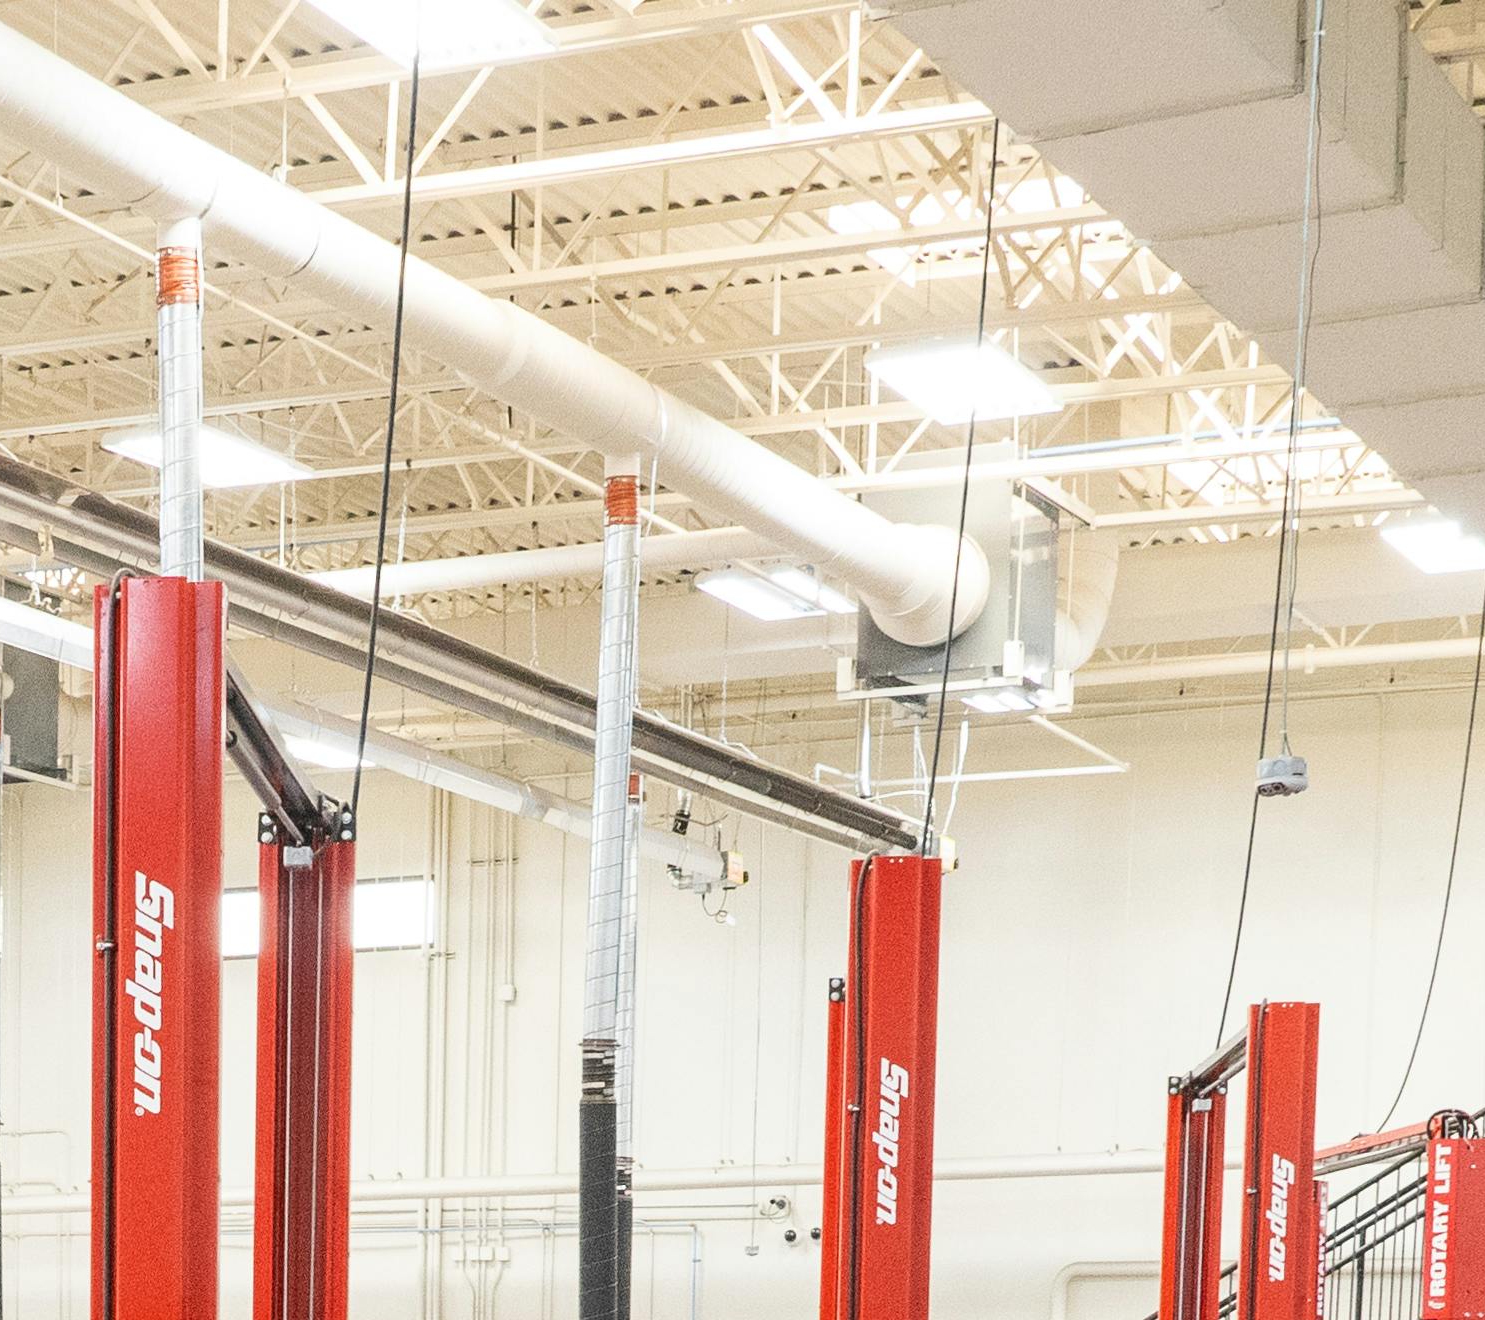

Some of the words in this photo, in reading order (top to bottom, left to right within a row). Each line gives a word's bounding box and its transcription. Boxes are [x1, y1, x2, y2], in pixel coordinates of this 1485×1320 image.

[125, 871, 175, 1115] Snap-on
[872, 1057, 909, 1225] Snap-on
[1434, 1143, 1452, 1194] LIFT
[1266, 1153, 1295, 1281] Snap-on
[1429, 1201, 1449, 1297] ROTARY
